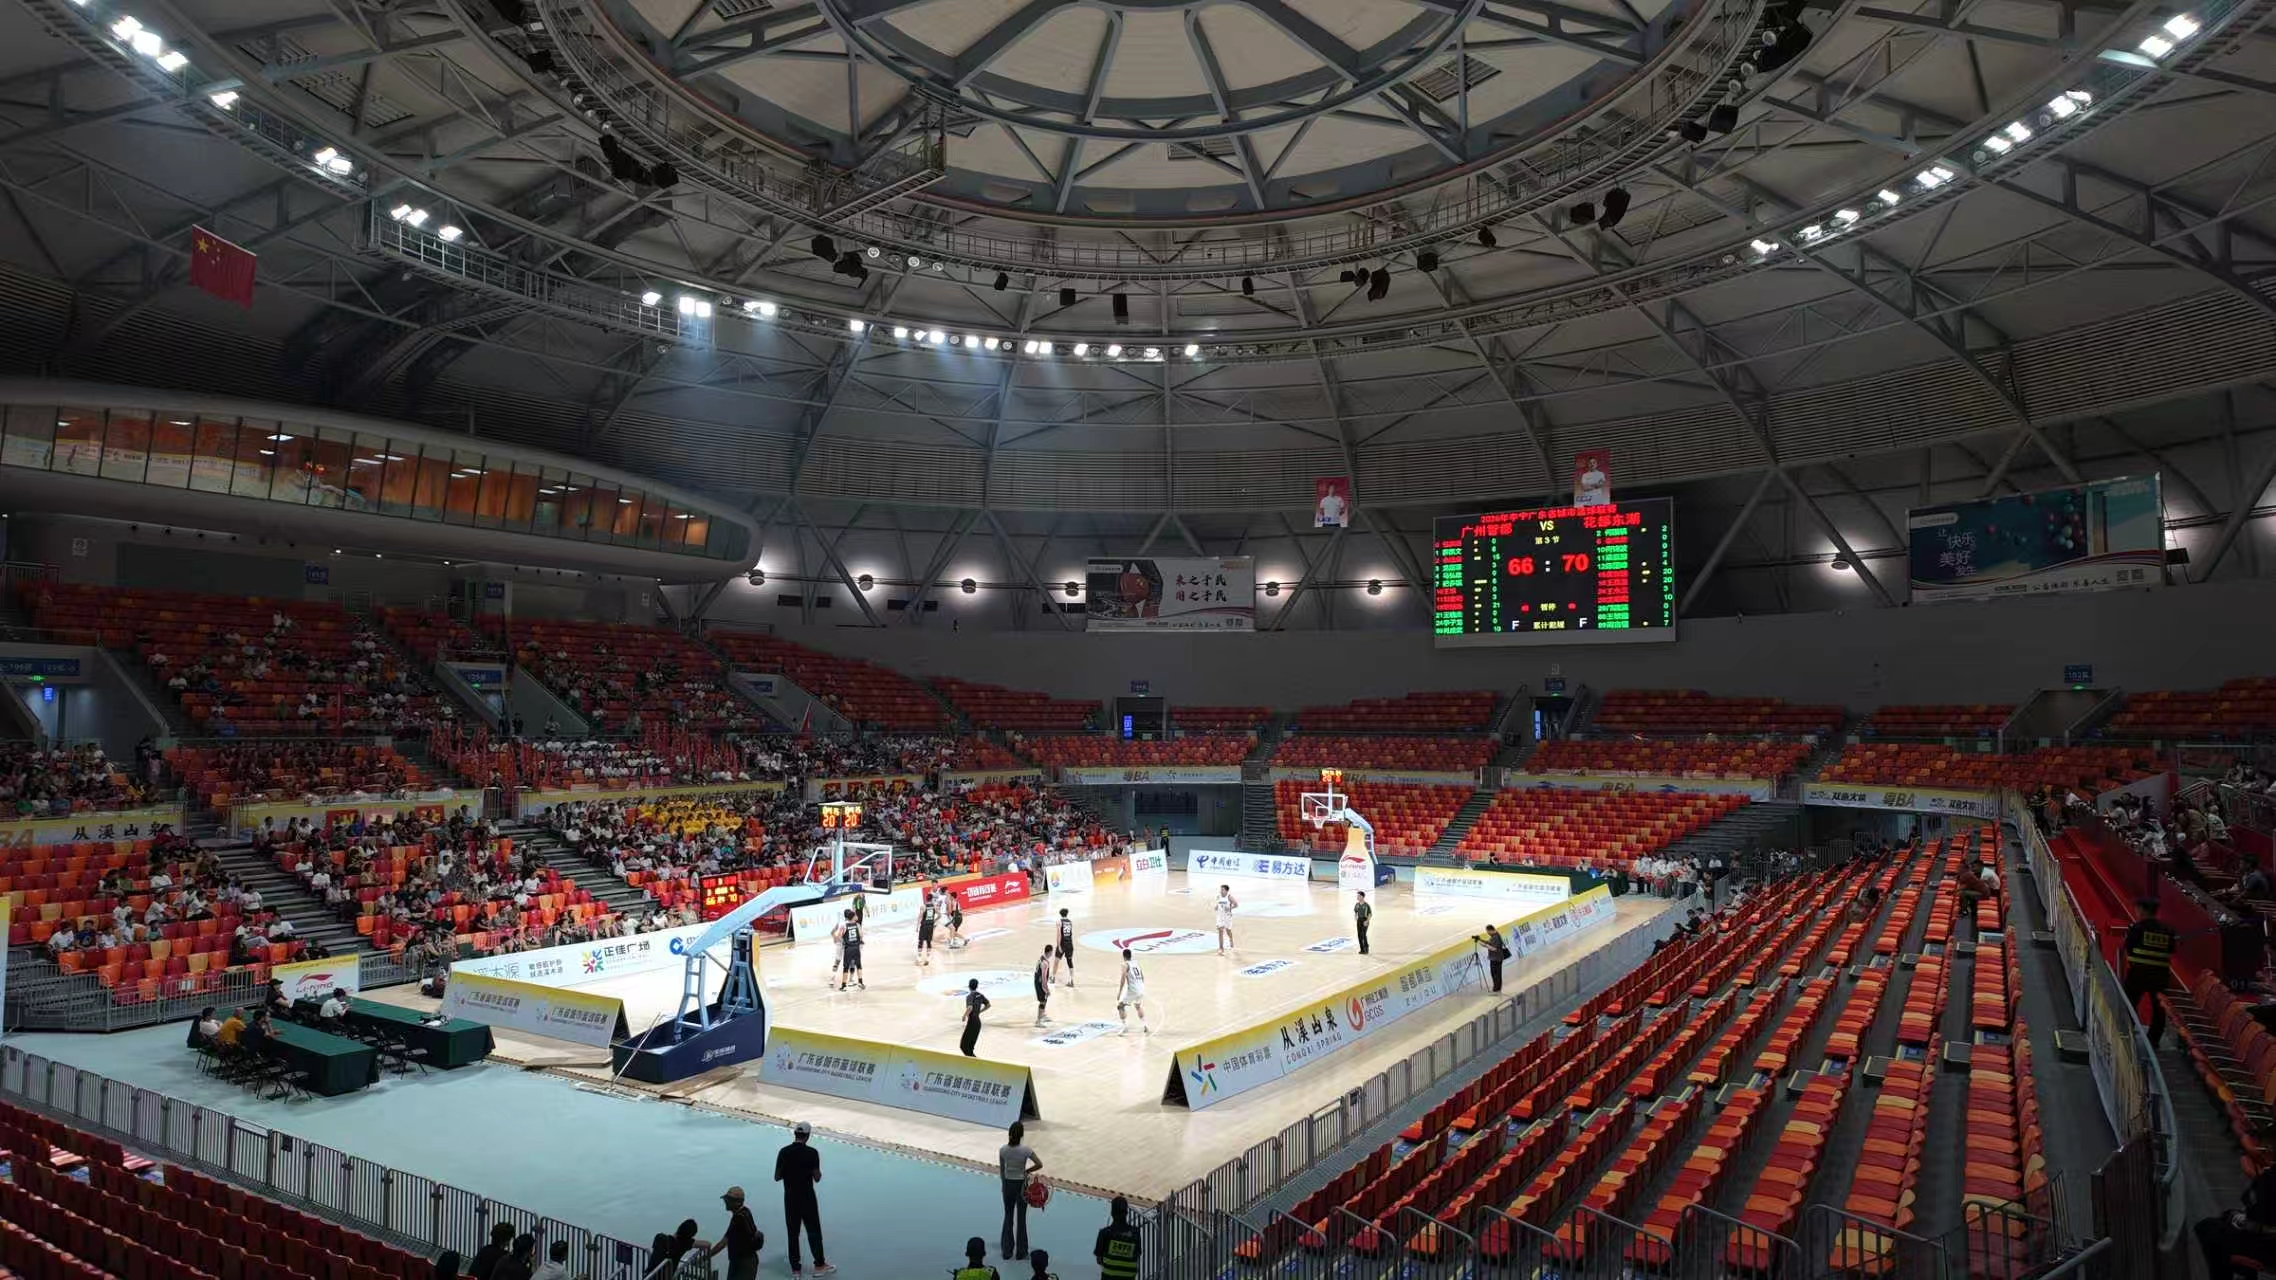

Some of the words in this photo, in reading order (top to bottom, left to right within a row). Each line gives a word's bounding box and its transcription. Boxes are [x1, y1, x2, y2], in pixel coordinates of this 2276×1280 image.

[1540, 520, 1554, 531] VS
[1508, 558, 1534, 575] 66
[1562, 554, 1588, 571] 70
[1512, 620, 1520, 630] F
[1580, 618, 1587, 628] F
[823, 814, 836, 827] 20
[845, 814, 857, 827] 20
[1271, 860, 1306, 876] 易方达
[603, 941, 651, 957] 正佳广场
[1280, 1005, 1338, 1051] 从溪山泉
[1317, 1032, 1342, 1051] SPRING
[798, 1052, 877, 1076] 广东省城市篮球联赛
[1222, 1046, 1272, 1073] 中国体育彩票
[925, 1072, 1012, 1099] 广东省城市篮球联赛
